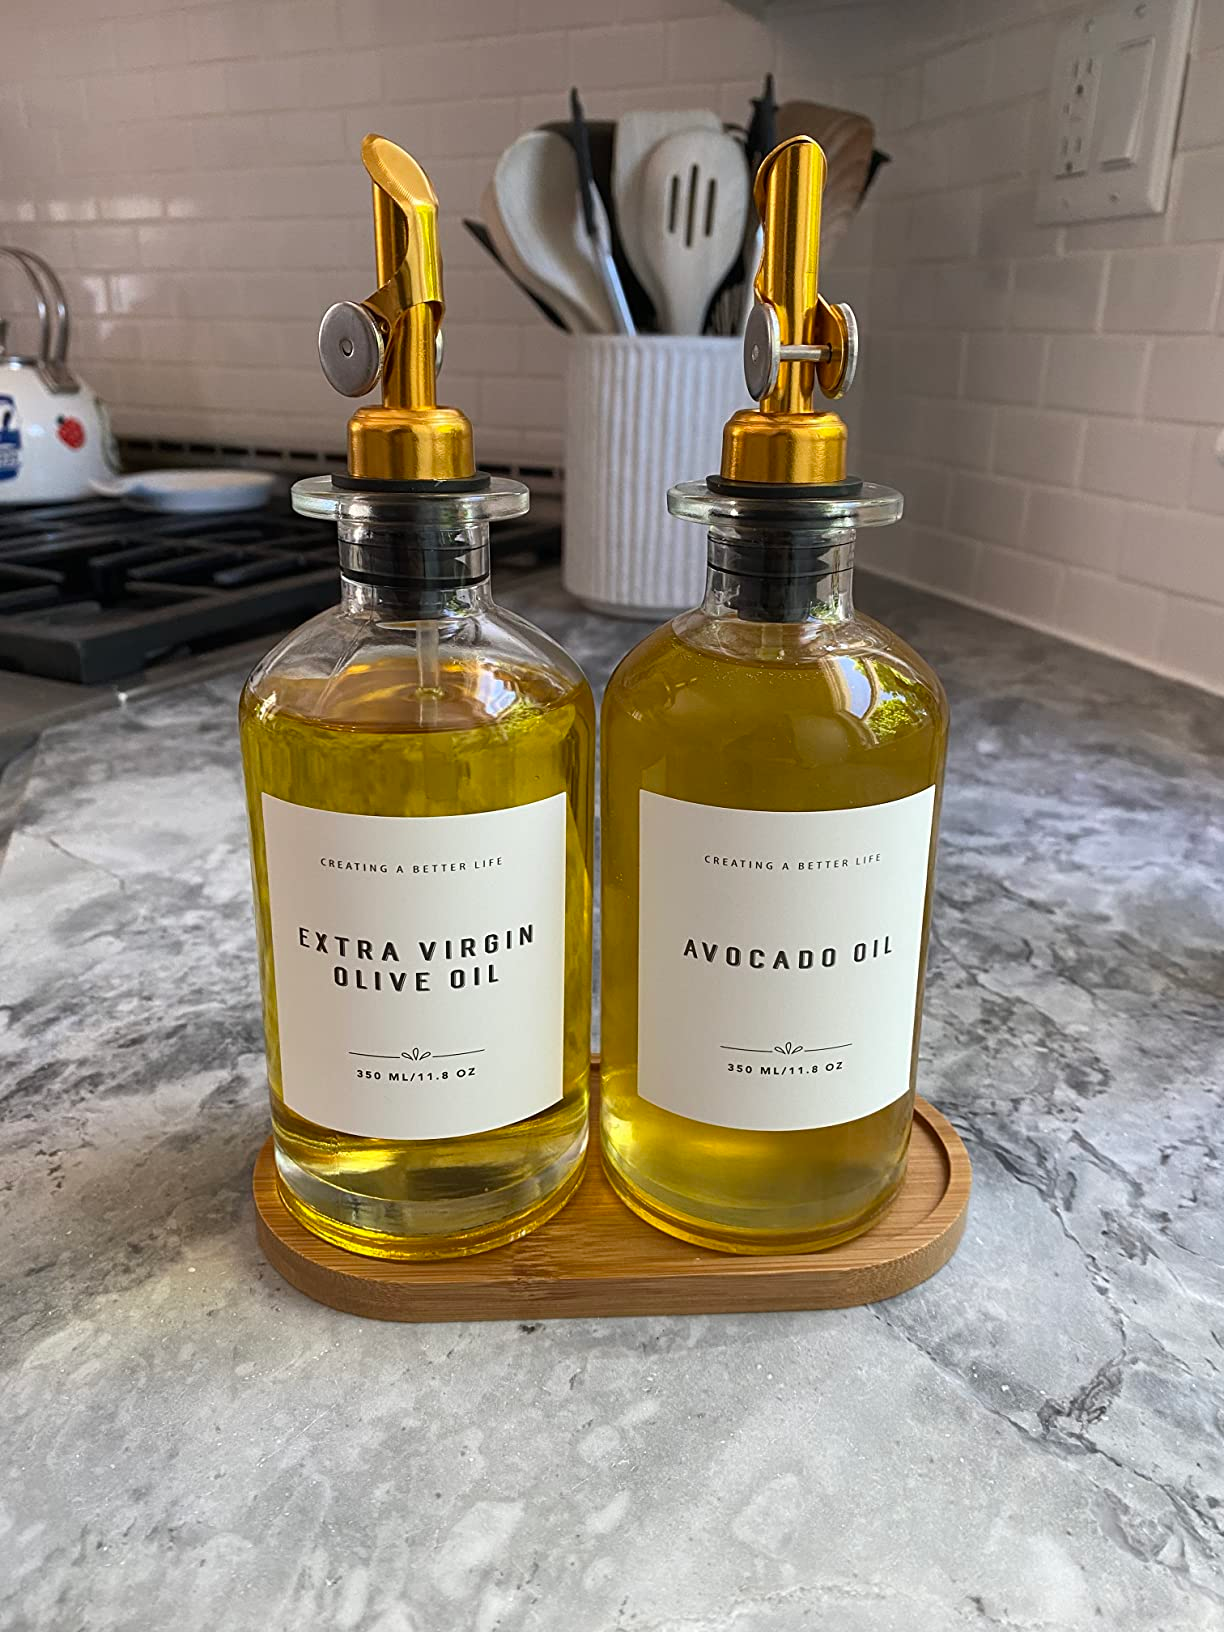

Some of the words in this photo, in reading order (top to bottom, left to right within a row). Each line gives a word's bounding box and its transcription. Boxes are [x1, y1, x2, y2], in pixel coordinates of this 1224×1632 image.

[320, 857, 388, 873] CREATING
[396, 864, 405, 873] A
[412, 862, 467, 873] BETTER
[474, 856, 503, 869] LIFE
[704, 854, 774, 870] CREATING
[781, 862, 790, 871] A
[798, 858, 849, 871] BETTER
[856, 853, 881, 866] LIFE
[298, 926, 400, 963] EXTRA
[419, 923, 534, 962] VIRGIN
[683, 938, 837, 970] AVOCADO
[853, 935, 893, 963] OIL
[333, 965, 431, 992] OLIVE
[450, 964, 499, 989] OIL
[356, 1068, 382, 1080] 350
[388, 1070, 449, 1082] ML/11.8
[456, 1066, 477, 1078] OZ
[727, 1062, 753, 1074] 350
[760, 1064, 819, 1076] ML/11.8
[825, 1060, 843, 1072] OZ
